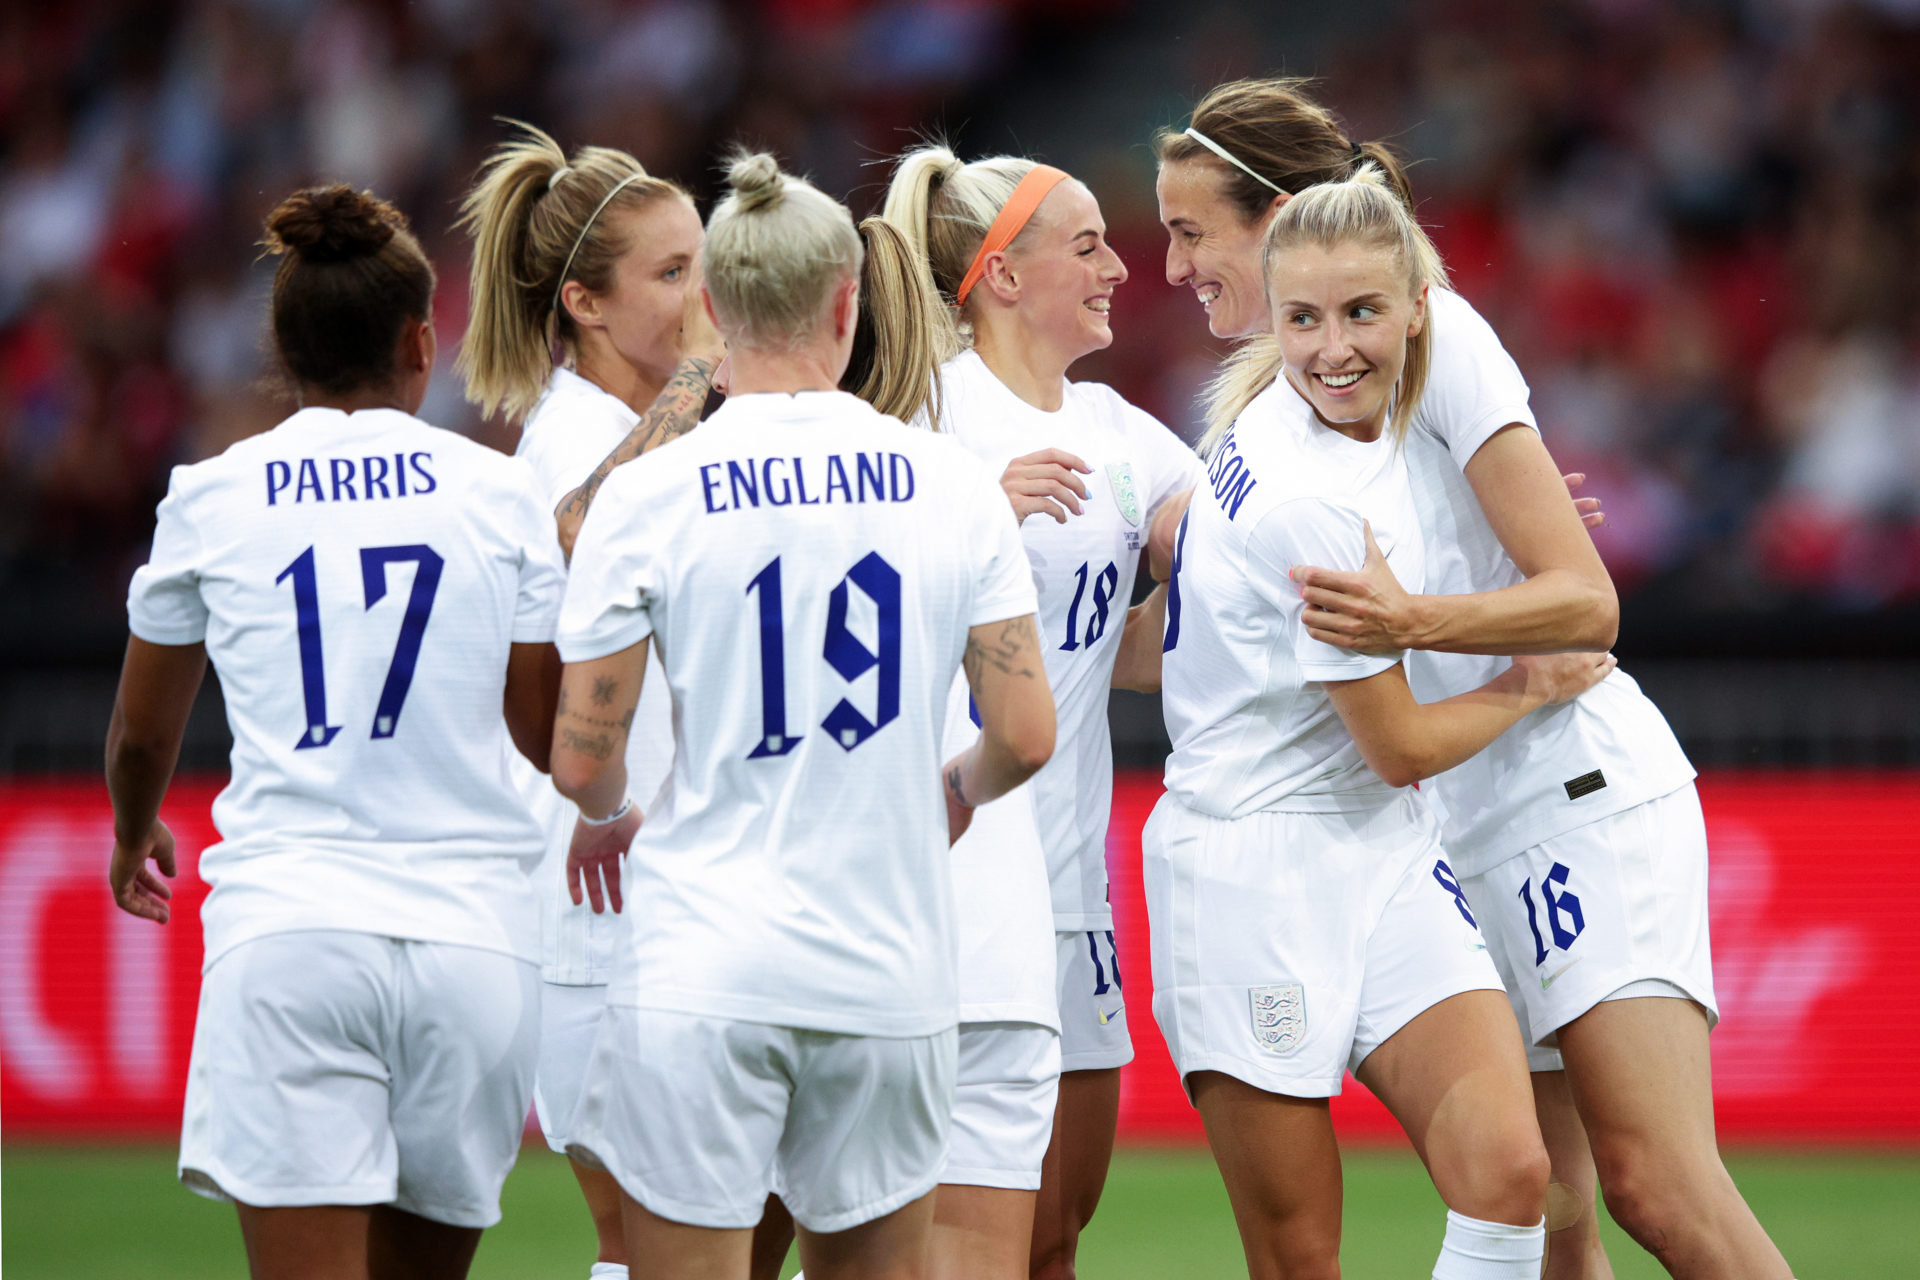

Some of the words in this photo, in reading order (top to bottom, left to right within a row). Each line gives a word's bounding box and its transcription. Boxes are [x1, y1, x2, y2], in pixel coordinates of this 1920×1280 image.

[265, 451, 438, 506] PARRIS
[699, 451, 916, 514] ENGLAND
[275, 543, 446, 751] 17
[745, 549, 902, 761] 19
[1057, 559, 1119, 652] 18
[1517, 861, 1586, 968] 16
